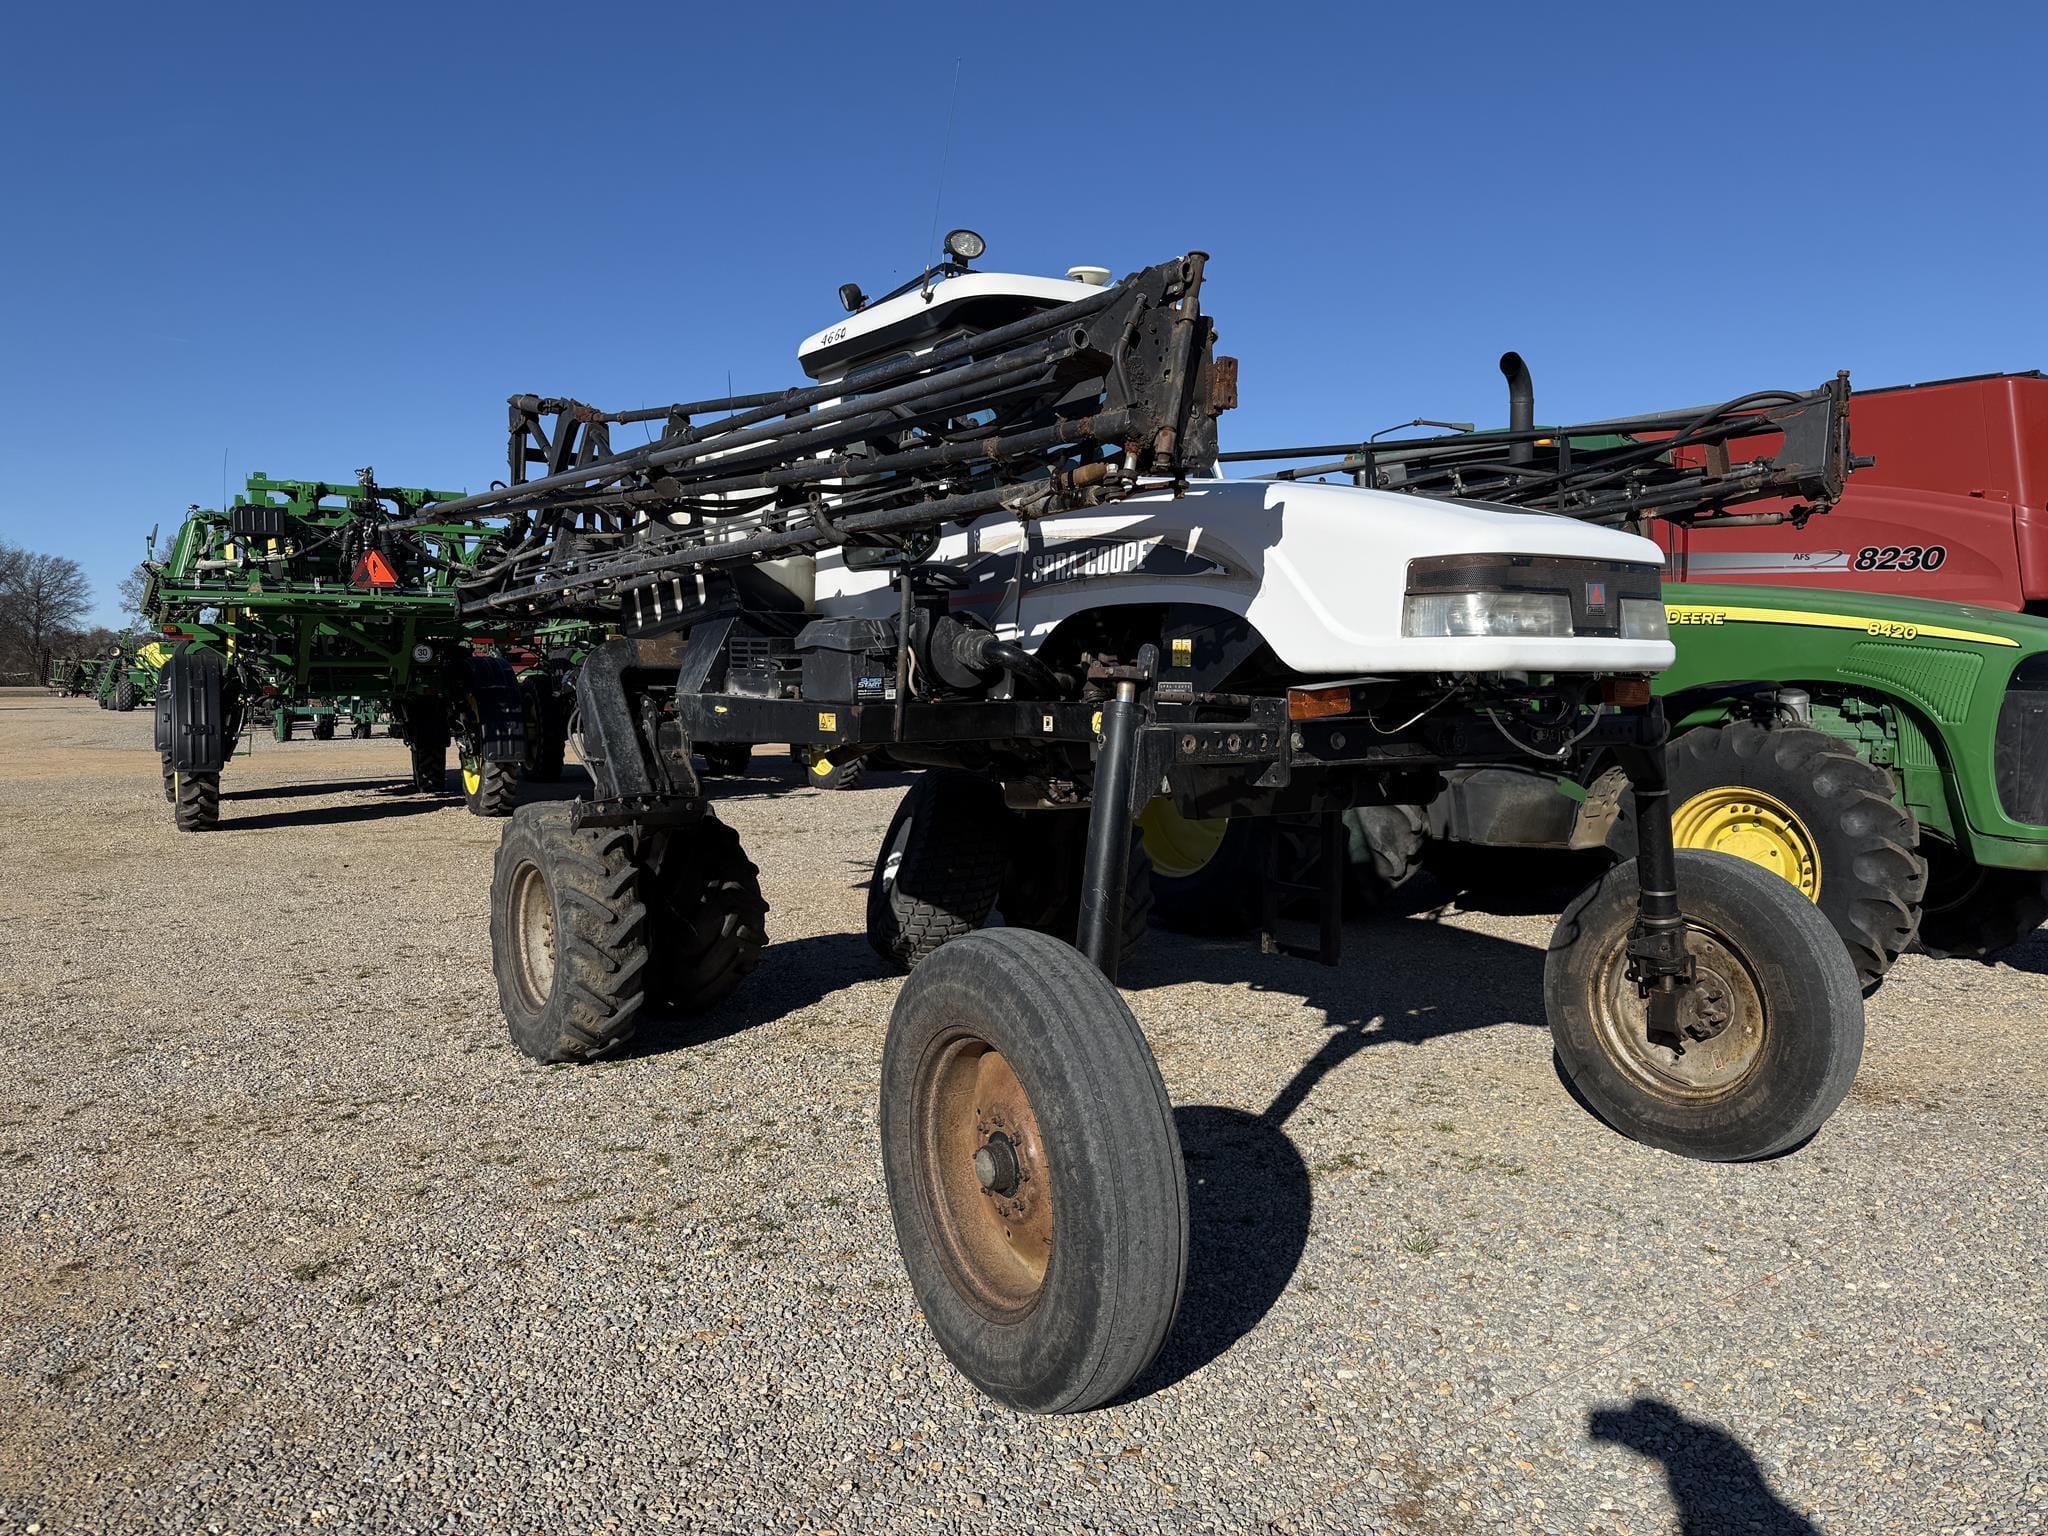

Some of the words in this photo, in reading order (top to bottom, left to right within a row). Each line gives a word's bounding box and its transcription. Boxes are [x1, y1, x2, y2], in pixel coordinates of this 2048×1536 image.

[821, 327, 846, 345] 4660
[1032, 551, 1078, 583] SPRA
[1085, 541, 1148, 576] COUPE
[1793, 553, 1811, 561] AFS
[1853, 544, 1947, 572] 8230
[1666, 609, 1726, 626] DEERE
[1867, 621, 1918, 640] 8420
